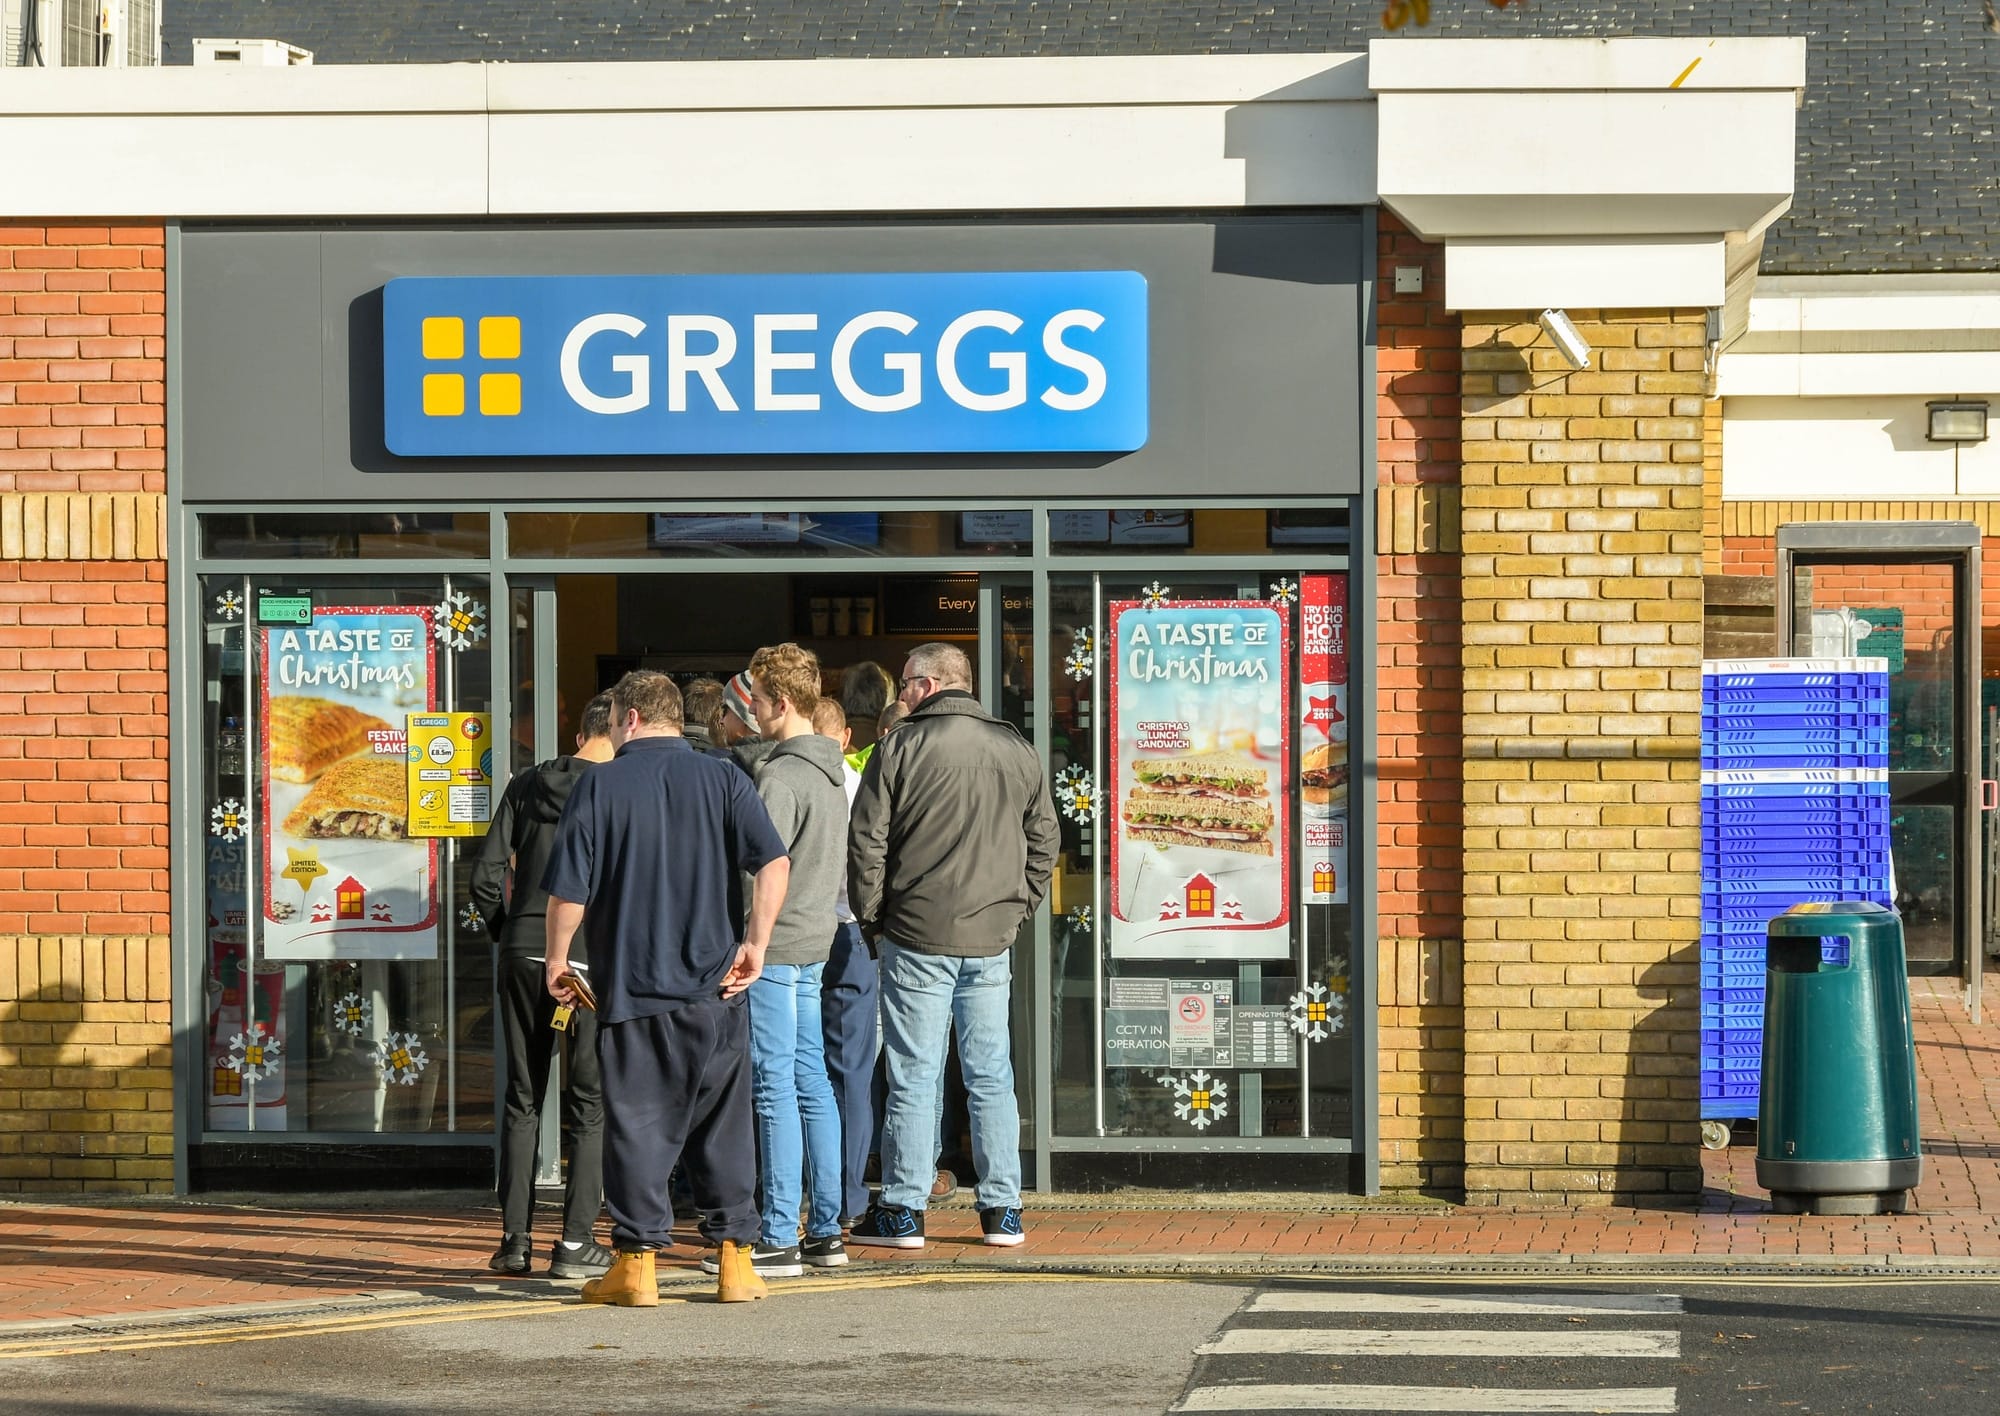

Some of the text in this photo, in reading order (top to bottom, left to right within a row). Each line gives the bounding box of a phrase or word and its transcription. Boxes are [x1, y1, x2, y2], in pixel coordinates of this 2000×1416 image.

[560, 309, 1107, 414] GREGGS
[938, 597, 976, 613] Every
[1304, 605, 1343, 614] TRY OUR
[1304, 614, 1343, 624] HO HO
[1129, 623, 1268, 646] A TASTE OF
[1304, 624, 1343, 639] HOT
[280, 629, 414, 652] A TASTE OF
[1304, 645, 1343, 655] RANGE
[1129, 646, 1269, 685] Christmas
[279, 652, 415, 690] Christmas
[1313, 712, 1334, 720] 2018
[421, 718, 448, 726] GREGGS
[1137, 722, 1189, 731] CHRISTMAS
[367, 730, 407, 742] FESTIV
[1148, 731, 1179, 740] LUNCH
[374, 742, 408, 754] BAKE
[1137, 740, 1190, 748] SANDWICH
[1306, 825, 1325, 833] PIGS
[225, 917, 247, 925] LATT
[1115, 1025, 1163, 1035] CCTV IN
[1106, 1039, 1171, 1049] OPERATION
